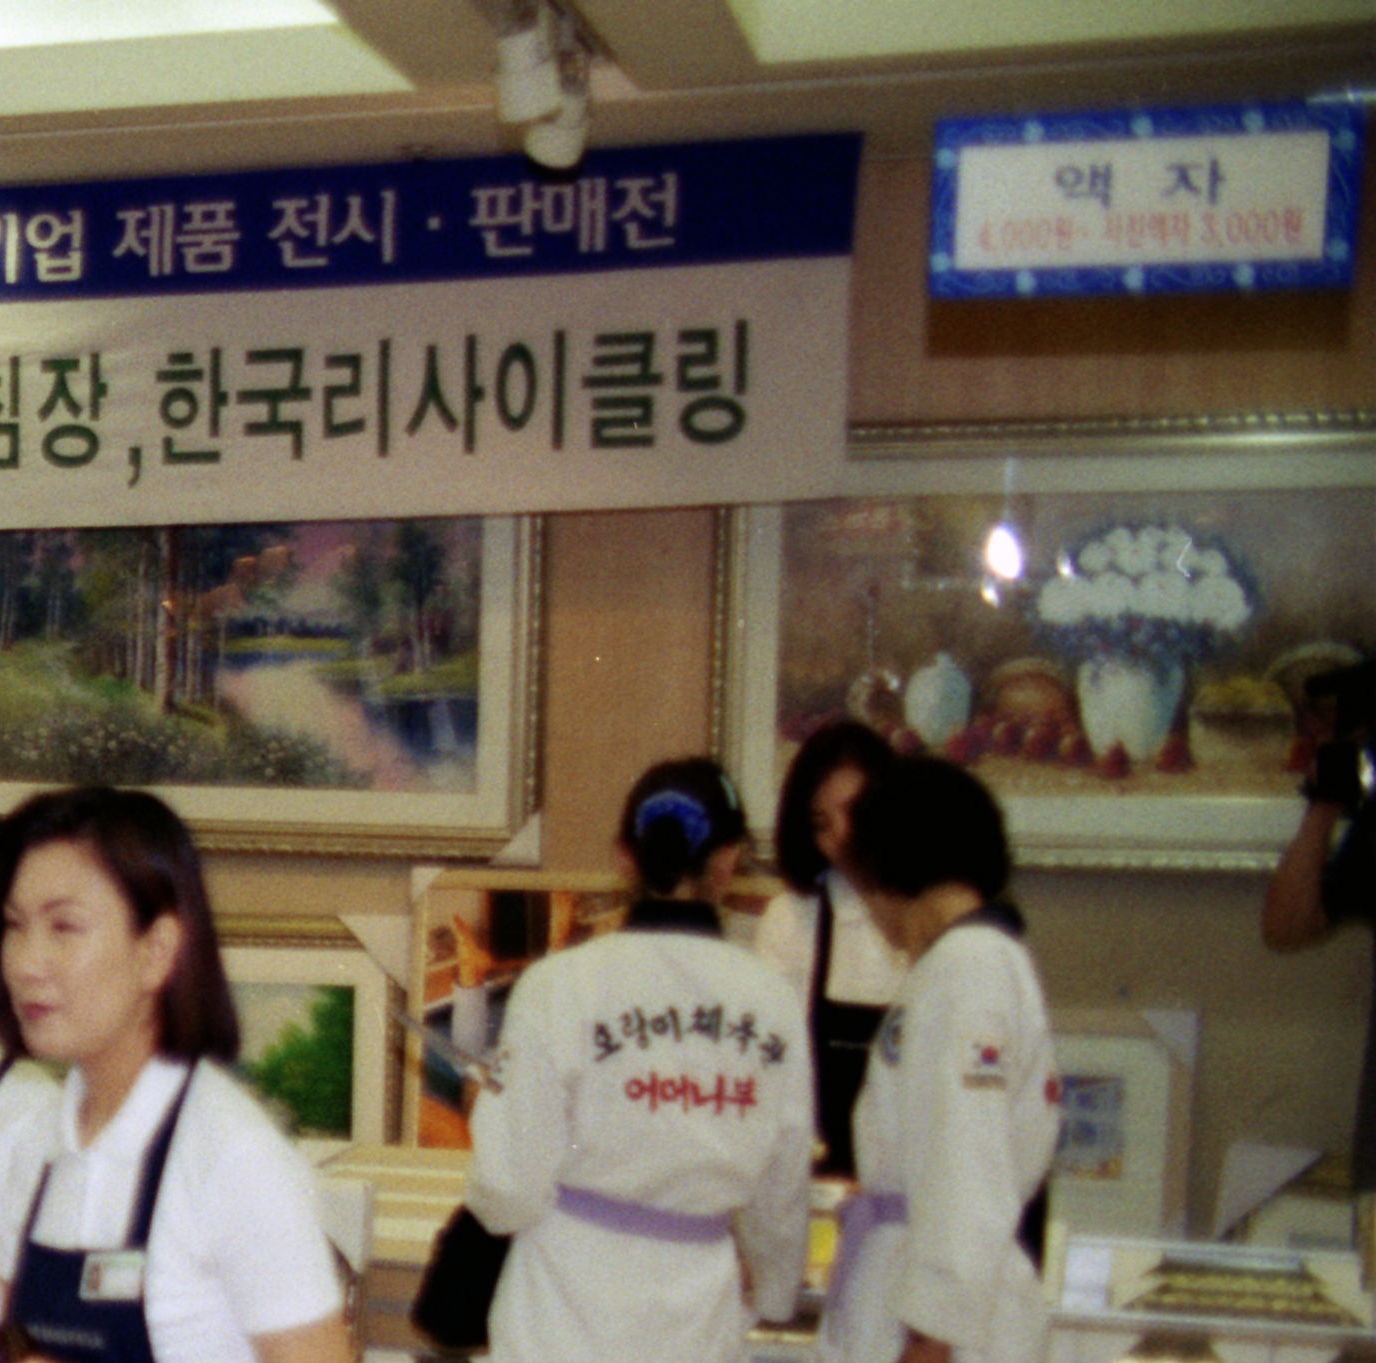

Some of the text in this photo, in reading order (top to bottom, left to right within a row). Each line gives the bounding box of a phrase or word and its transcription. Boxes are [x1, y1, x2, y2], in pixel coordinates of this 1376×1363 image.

[1163, 152, 1227, 205] 자
[112, 200, 243, 277] 제품
[268, 190, 399, 268] 전시
[468, 172, 680, 258] 판매전
[625, 1071, 758, 1120] 어머니부
